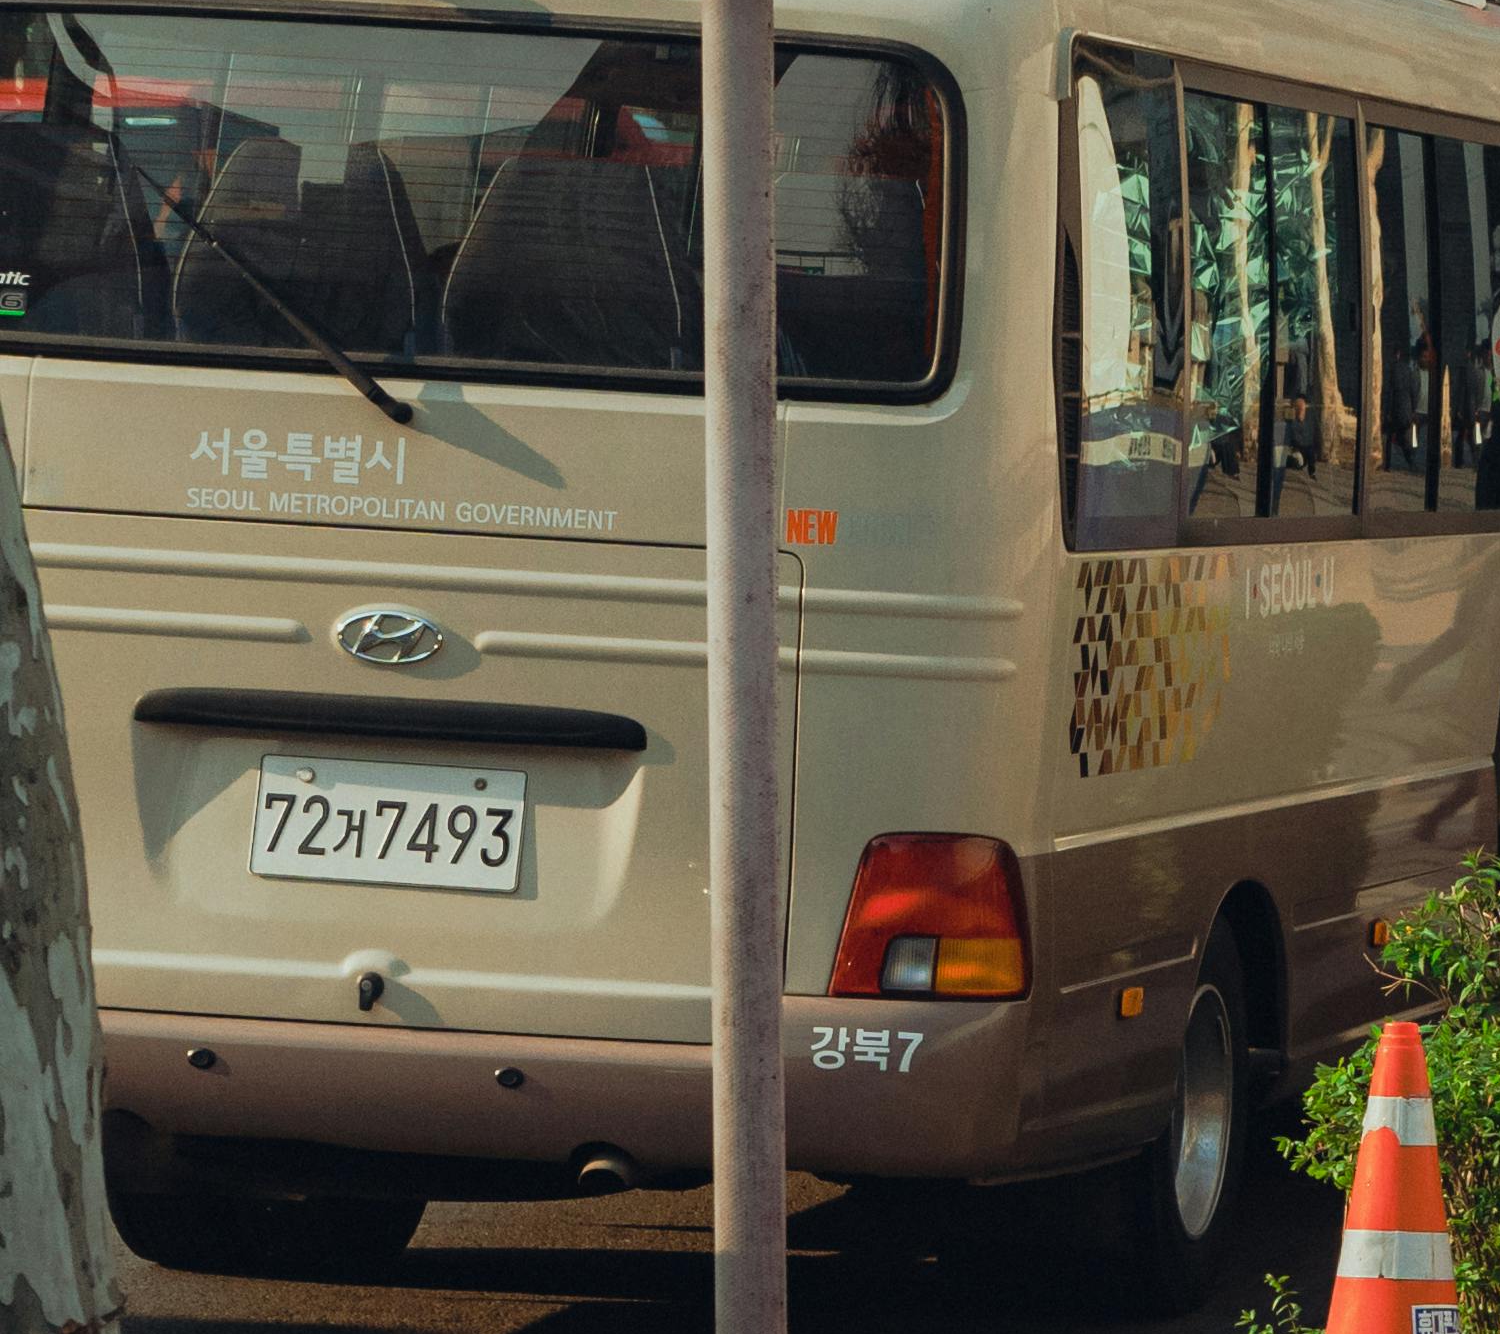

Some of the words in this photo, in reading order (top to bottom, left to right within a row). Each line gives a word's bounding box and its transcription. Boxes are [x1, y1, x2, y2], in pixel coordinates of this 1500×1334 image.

[190, 428, 407, 486] 서울특별시
[186, 487, 261, 512] SEOUL
[268, 492, 446, 522] METROPOLITAN
[456, 502, 618, 532] GOVERNMENT
[786, 508, 839, 545] NEW
[264, 792, 514, 868] 72거7493
[810, 1026, 924, 1073] 강북7
